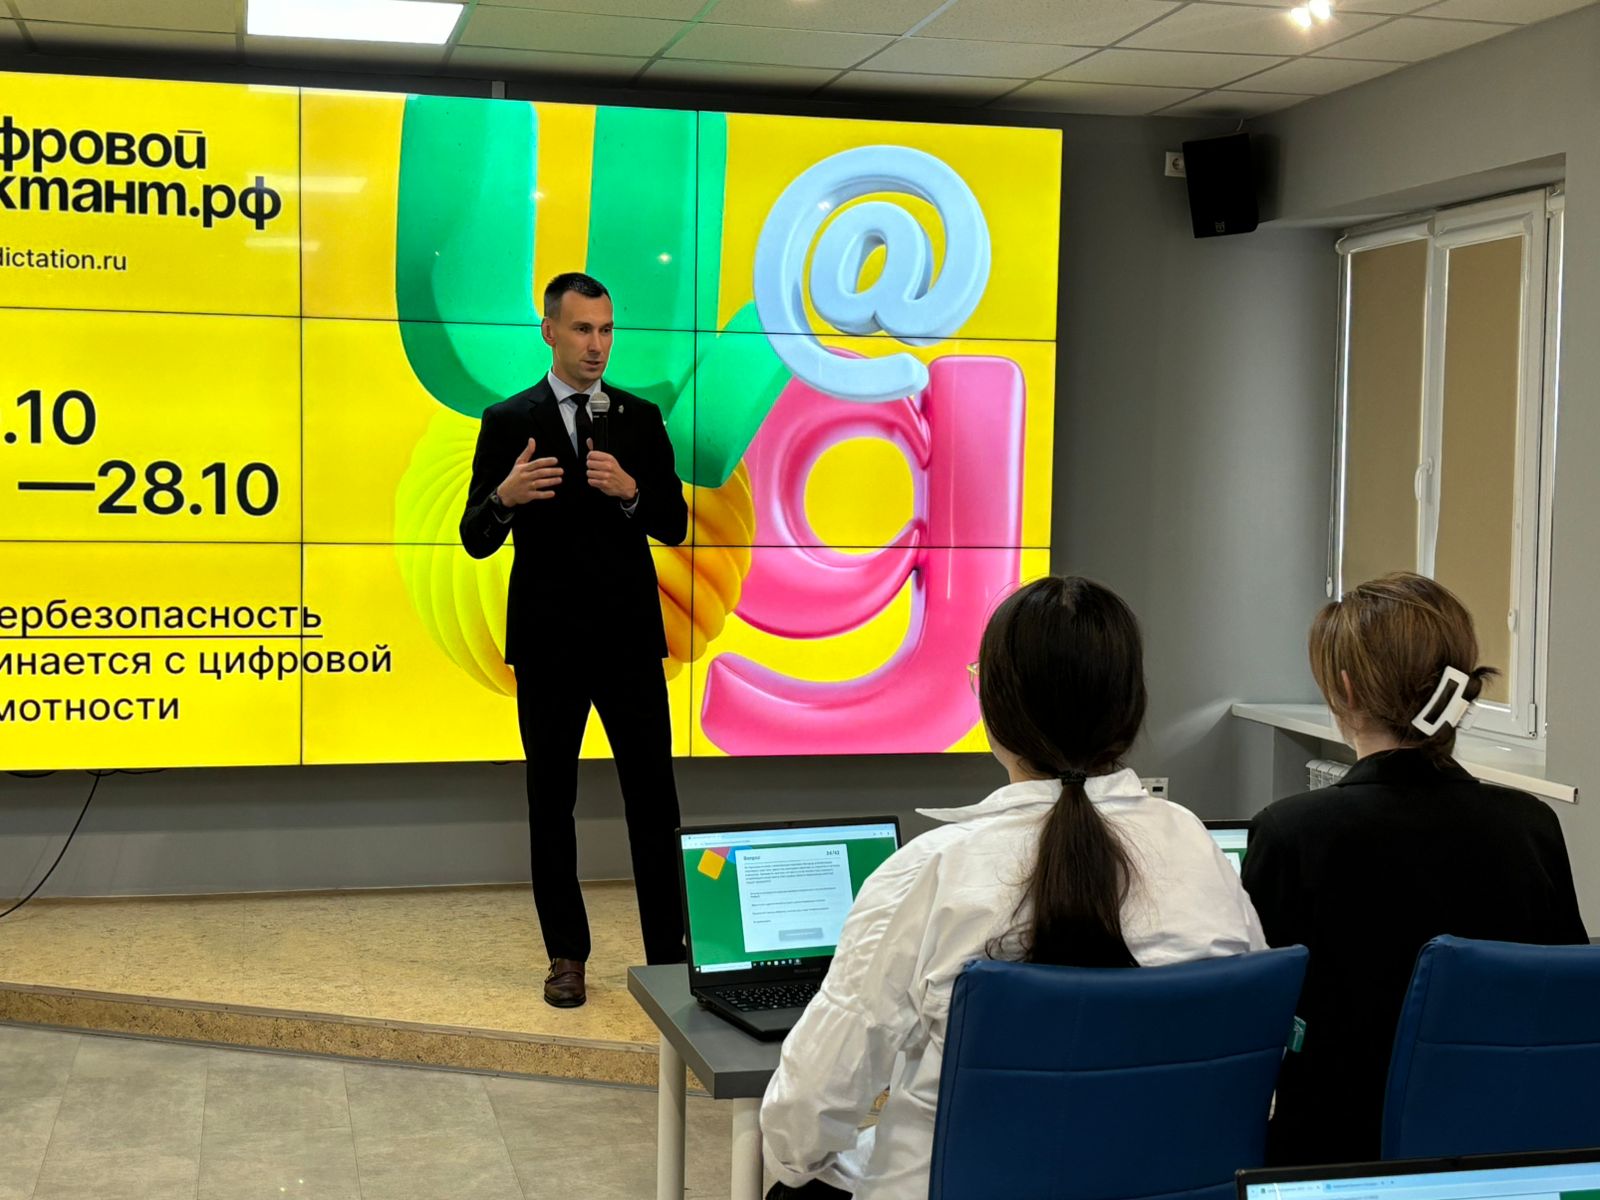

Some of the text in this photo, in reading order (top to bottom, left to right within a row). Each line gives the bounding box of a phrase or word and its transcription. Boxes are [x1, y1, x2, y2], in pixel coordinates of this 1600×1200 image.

[0, 599, 322, 637] ербезопасность
[165, 652, 185, 675] с
[199, 644, 391, 681] цифровой
